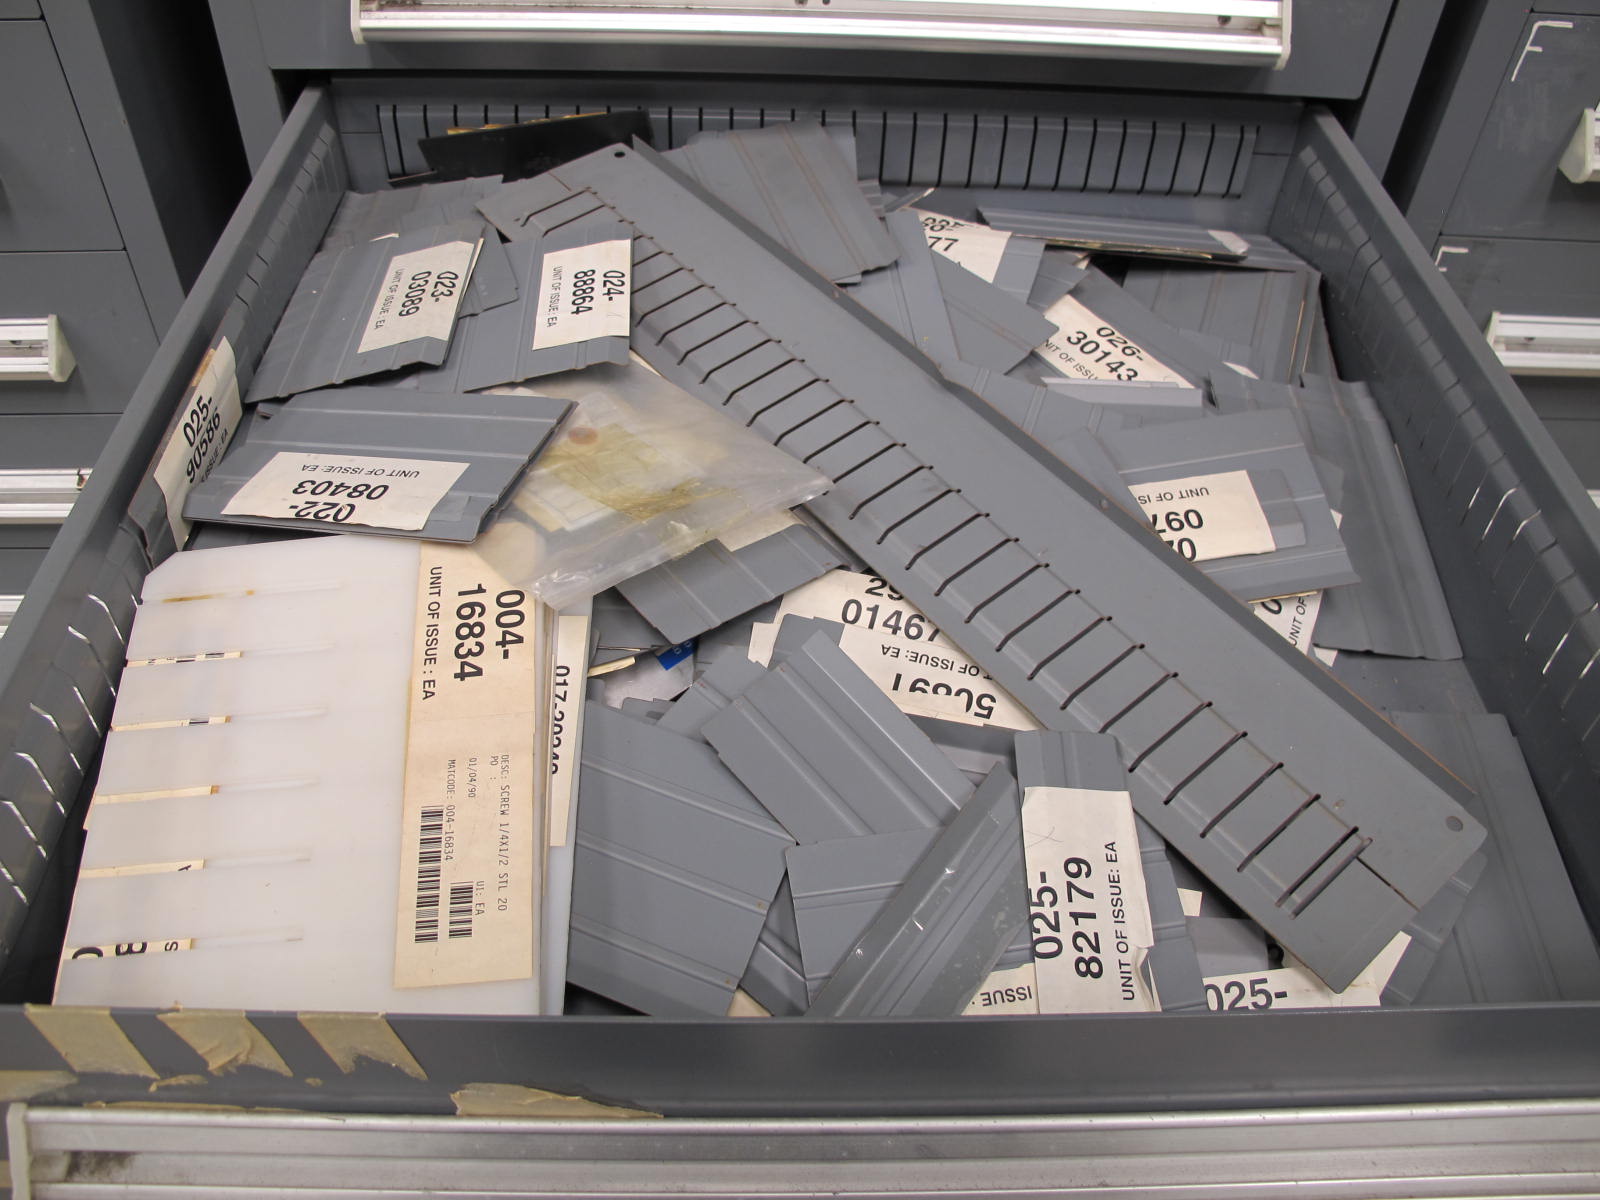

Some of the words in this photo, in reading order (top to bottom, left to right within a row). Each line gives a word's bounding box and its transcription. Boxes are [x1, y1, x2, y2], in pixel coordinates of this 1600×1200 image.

[551, 265, 563, 281] UNIT
[398, 270, 432, 317] 03089
[431, 271, 459, 303] 023-
[551, 282, 561, 292] OF
[570, 269, 596, 315] 88864
[602, 270, 626, 302] 024-
[374, 318, 386, 330] EA
[546, 316, 558, 328] EA
[1066, 330, 1138, 381] 30143
[1096, 326, 1144, 362] 026-
[1044, 338, 1062, 353] NIT
[1058, 352, 1075, 364] OF
[1072, 363, 1099, 380] ISSU
[182, 395, 213, 448] 025-
[186, 407, 221, 484] 90586
[300, 464, 319, 472] EA
[324, 465, 363, 475] ISSUE:
[365, 467, 385, 476] OF
[391, 468, 420, 478] UNIT
[292, 480, 390, 501] 08403
[1155, 491, 1174, 502] OF
[1178, 486, 1210, 500] UNIT
[288, 500, 356, 522] 022-
[428, 566, 443, 597] UNIT
[427, 601, 441, 620] OF
[453, 583, 487, 682] 16834
[495, 589, 526, 660] 004-
[1288, 616, 1303, 647] UNIT
[881, 643, 901, 659] EA
[904, 650, 955, 672] ISSUE:
[957, 664, 980, 677] OF
[422, 679, 436, 701] EA
[490, 756, 499, 767] PO
[500, 754, 510, 780] DESC:
[446, 759, 457, 800] MATCODE:
[467, 757, 478, 798] 01/04/90
[500, 784, 510, 816] SCREW
[444, 804, 456, 861] 004-16834
[499, 823, 510, 866] 1/4X1/2
[1104, 841, 1118, 863] EA
[475, 880, 485, 897] UI:
[498, 872, 509, 892] STL
[474, 901, 485, 916] EA
[498, 897, 508, 912] 20
[1108, 868, 1125, 924] ISSUE:
[1028, 871, 1064, 960] 025-
[1063, 856, 1104, 979] 82179
[1115, 929, 1129, 954] OF
[1119, 958, 1135, 1001] UNIT
[1205, 977, 1288, 1011] 025-
